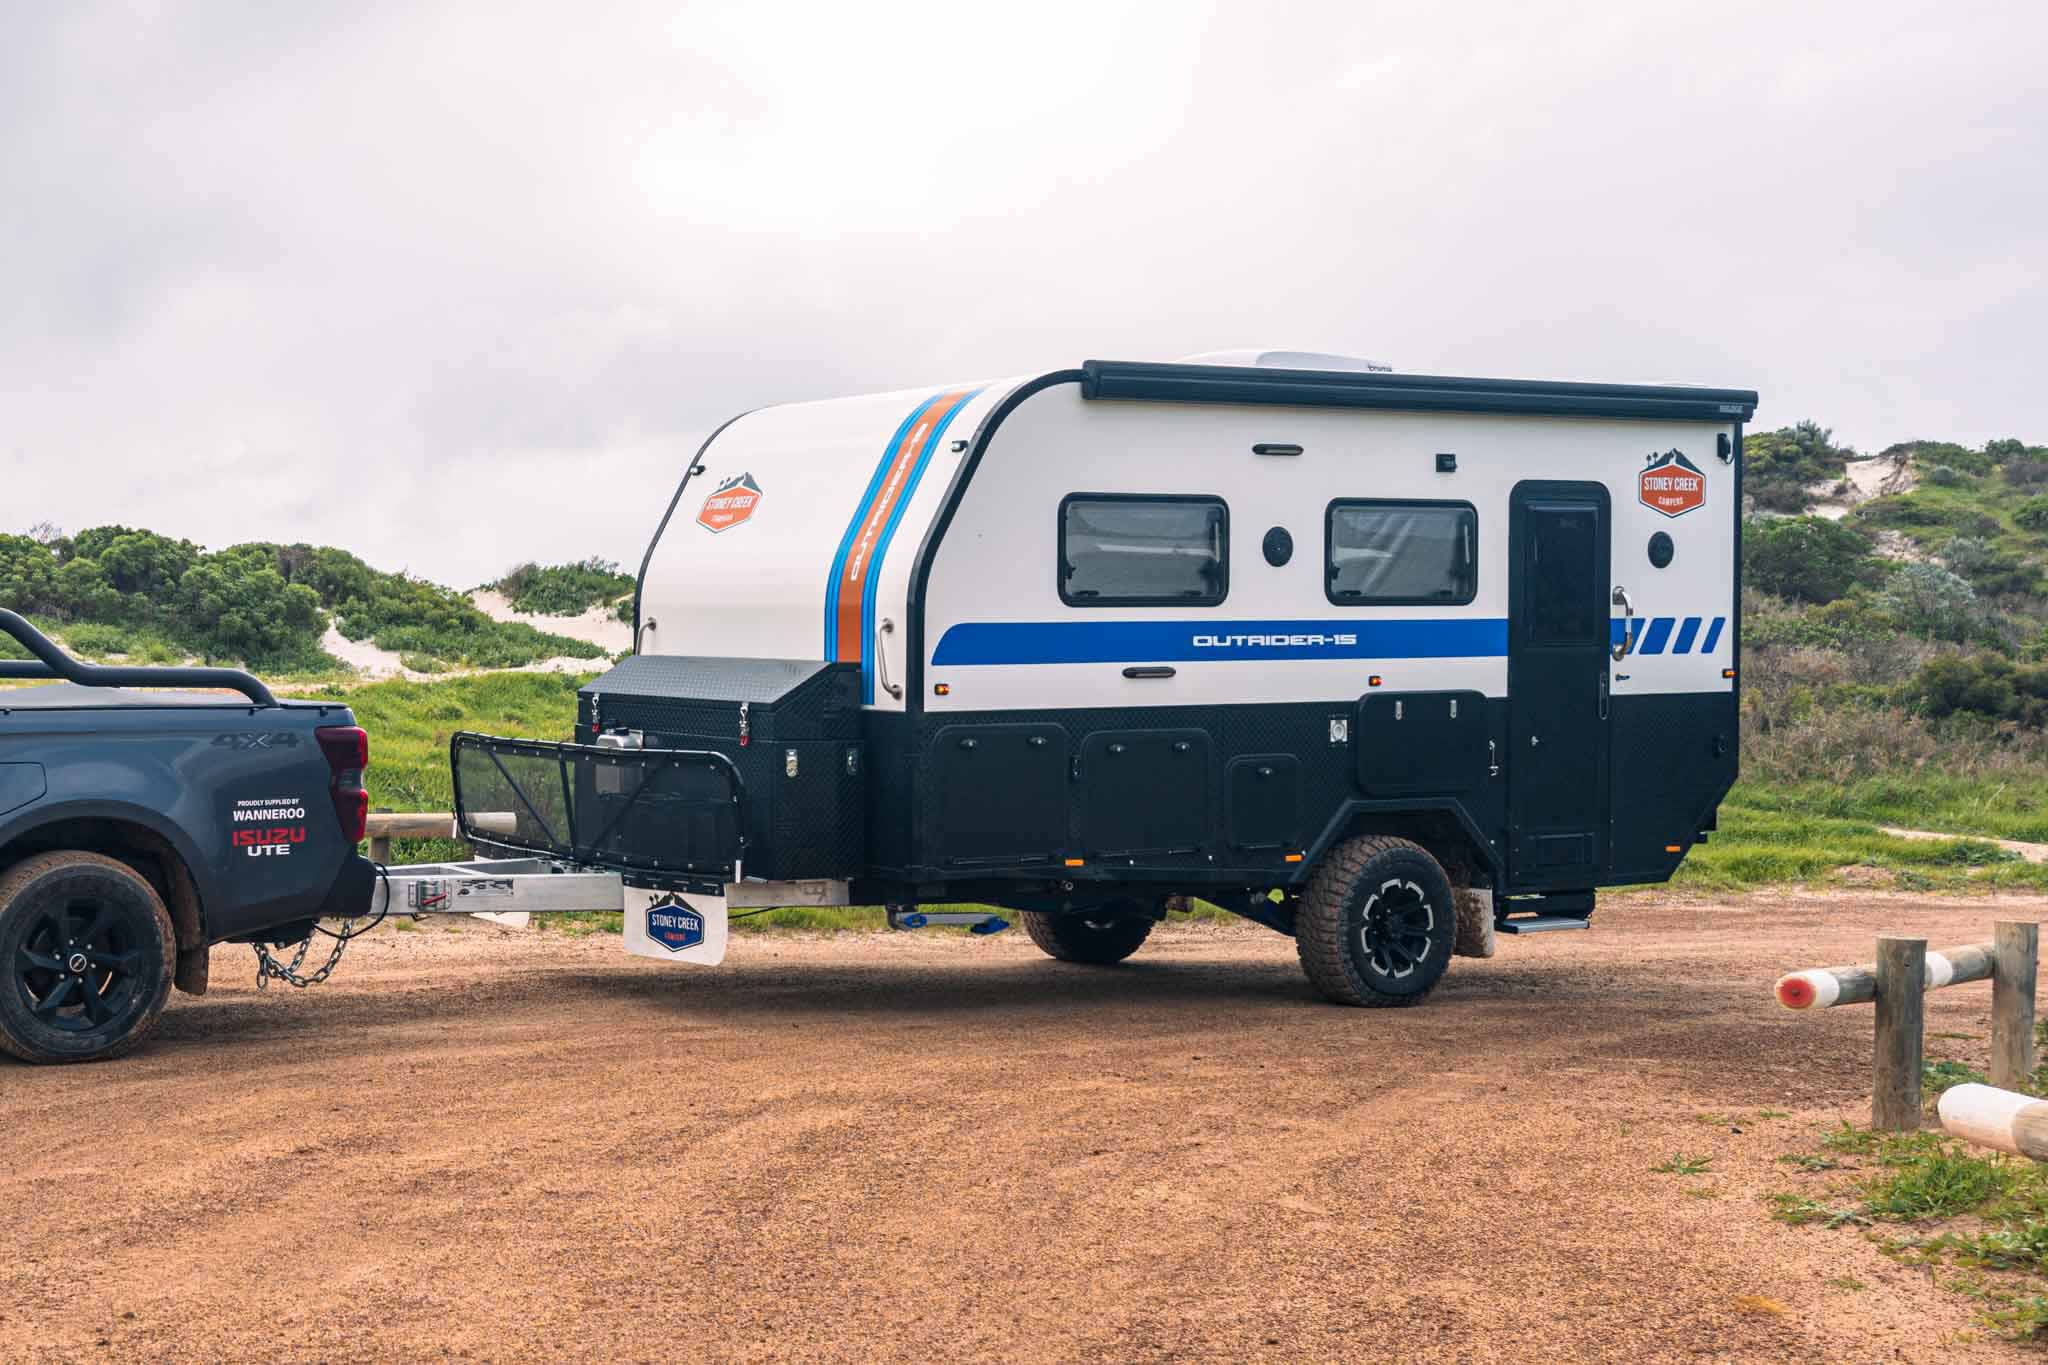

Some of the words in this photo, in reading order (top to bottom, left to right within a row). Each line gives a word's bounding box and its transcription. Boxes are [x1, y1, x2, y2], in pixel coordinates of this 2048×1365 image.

[1644, 477, 1673, 491] STONEY
[1674, 477, 1698, 491] CREEK
[1192, 634, 1357, 647] OUTRIDER-15
[233, 808, 305, 821] WANNEROO
[232, 826, 305, 846] ISUZU
[247, 844, 291, 857] UTE
[652, 914, 677, 928] STONEY
[678, 916, 699, 931] CREEK
